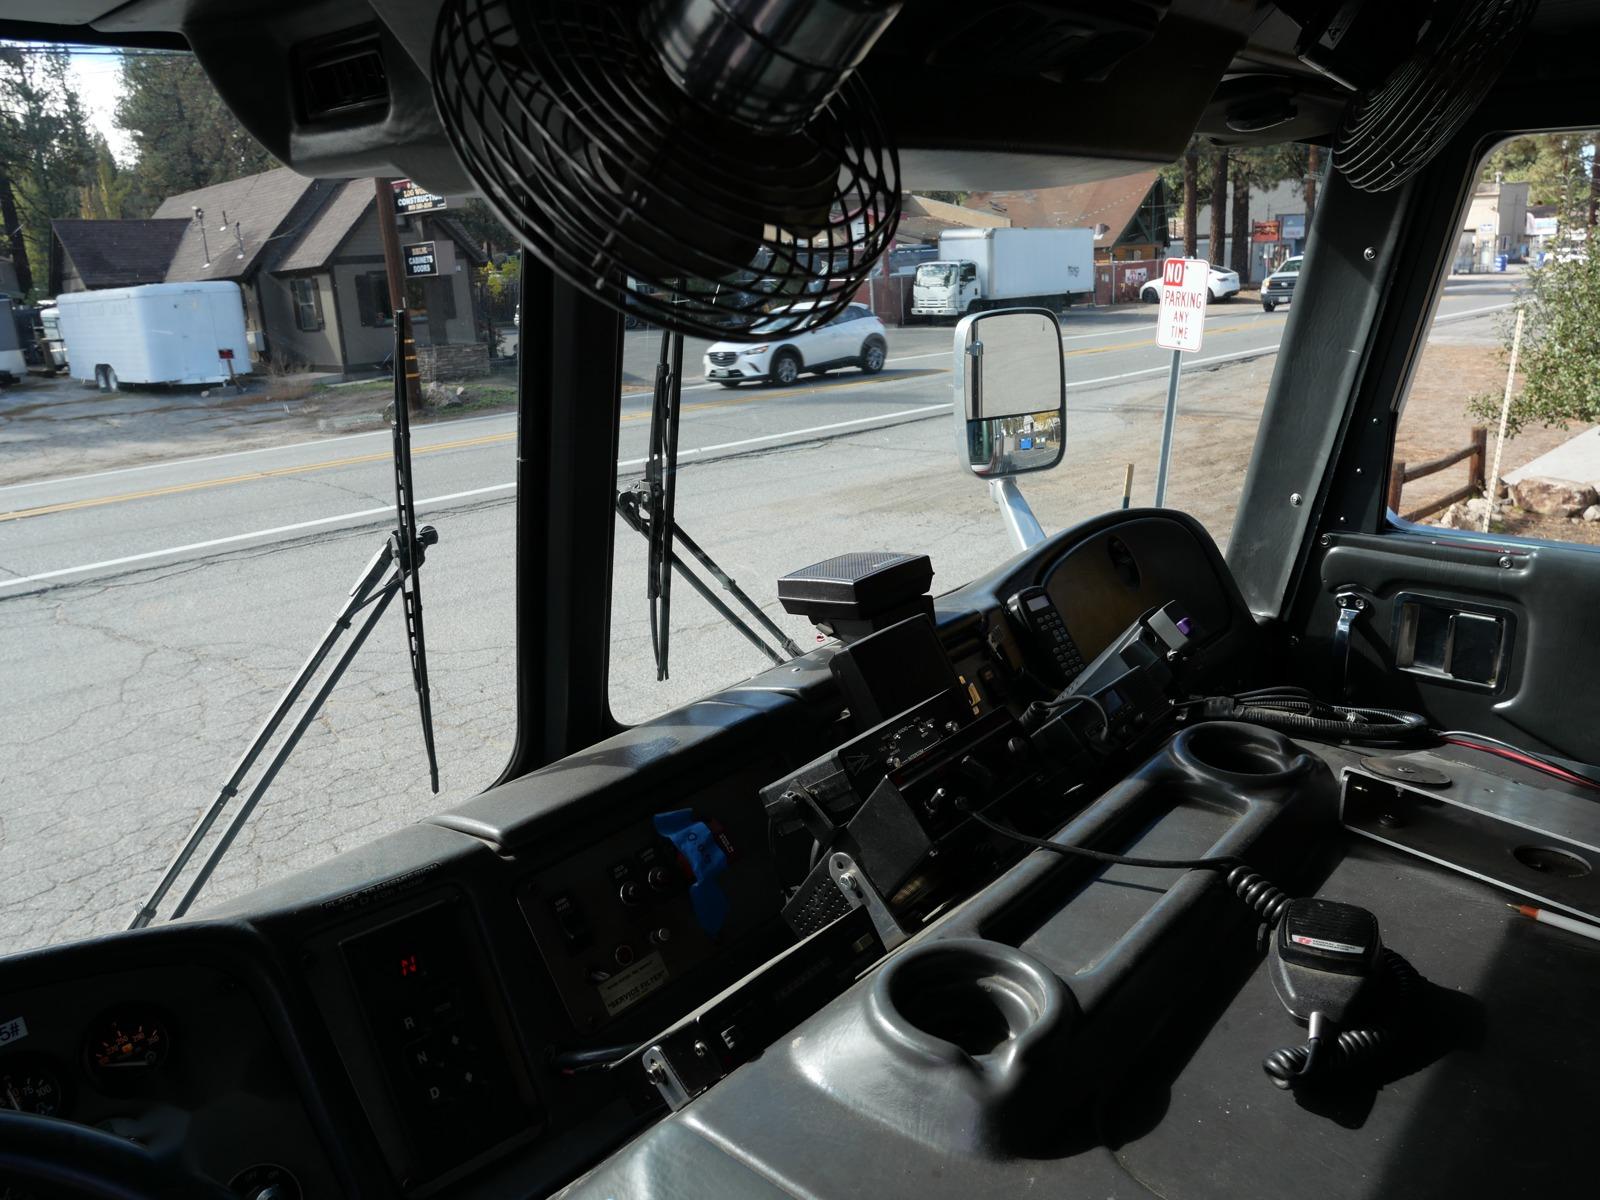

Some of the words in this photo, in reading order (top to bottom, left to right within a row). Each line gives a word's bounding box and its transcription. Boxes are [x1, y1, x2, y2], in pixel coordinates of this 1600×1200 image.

[408, 255, 434, 265] CABINETS
[413, 264, 431, 273] DOORS
[1165, 263, 1182, 283] NO
[1164, 290, 1202, 309] PARKING
[1173, 310, 1190, 323] ANY
[1171, 325, 1189, 340] TIME
[403, 1017, 415, 1030] R
[416, 1050, 429, 1065] N
[429, 1085, 441, 1101] D
